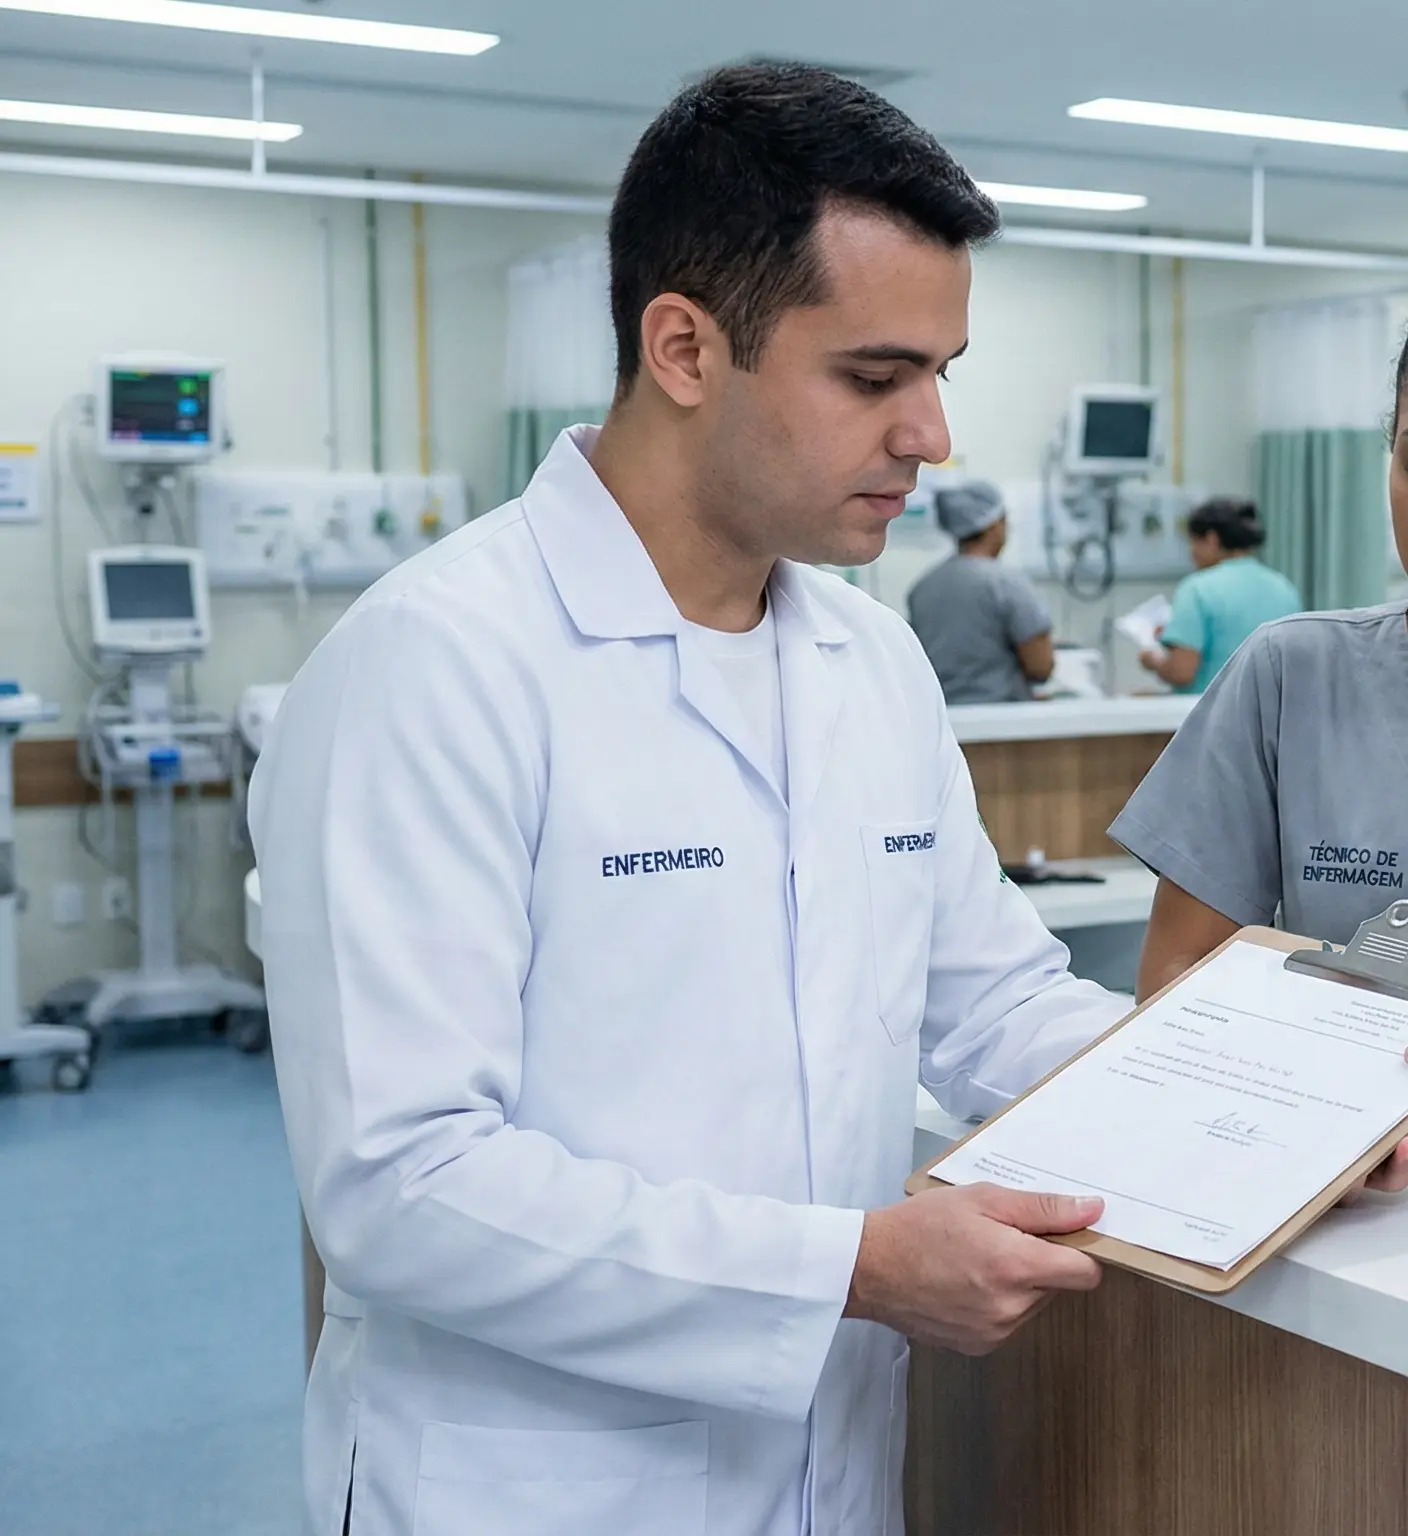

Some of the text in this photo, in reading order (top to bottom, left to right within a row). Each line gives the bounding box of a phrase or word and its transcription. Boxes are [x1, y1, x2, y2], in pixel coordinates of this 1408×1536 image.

[602, 846, 724, 877] ENFERMEIRO
[1309, 840, 1399, 867] TÉCNICO DE
[1303, 866, 1404, 888] ENFERMAGEM
